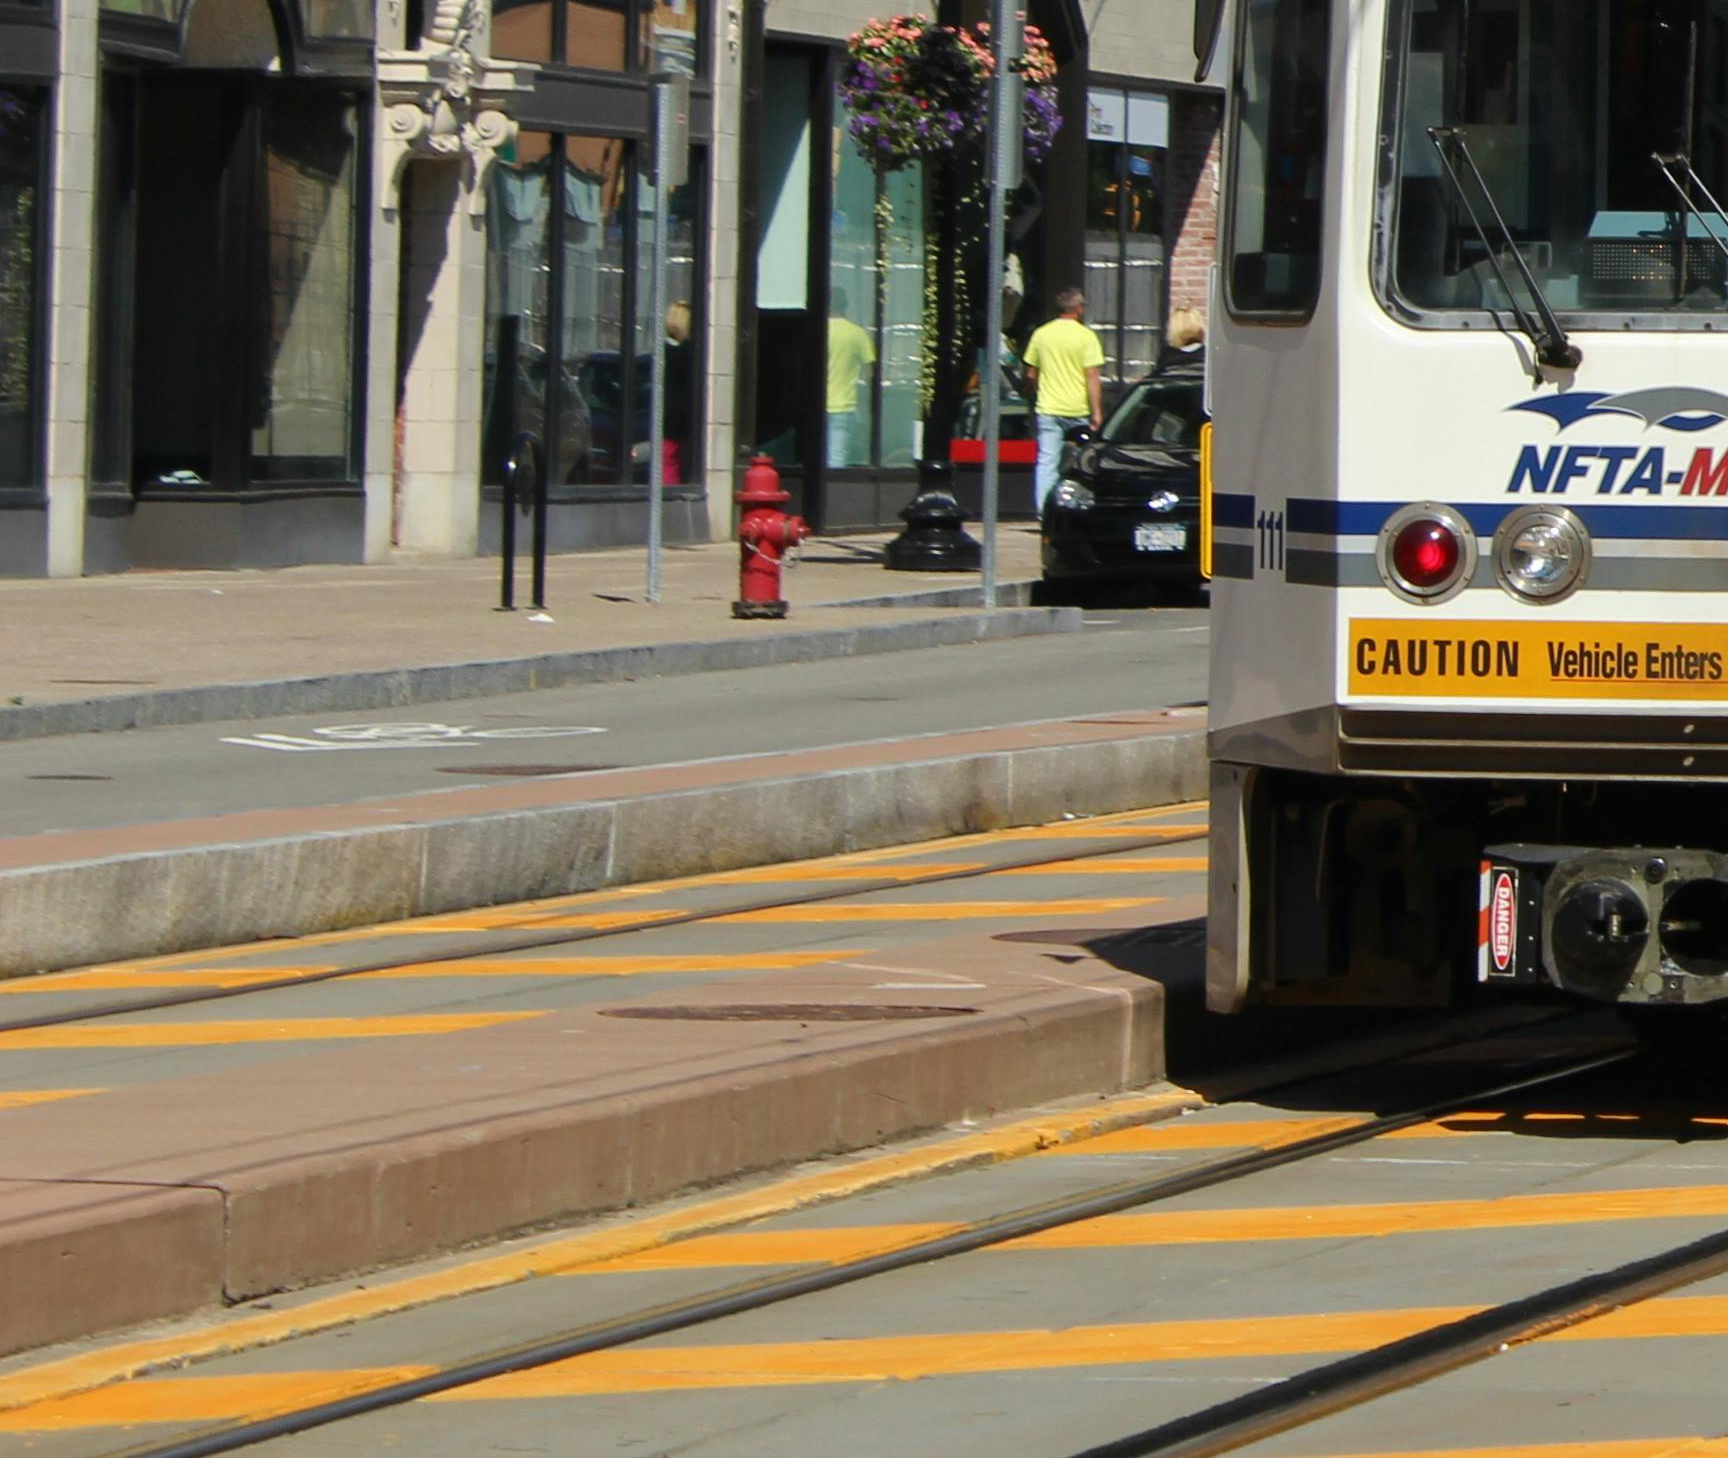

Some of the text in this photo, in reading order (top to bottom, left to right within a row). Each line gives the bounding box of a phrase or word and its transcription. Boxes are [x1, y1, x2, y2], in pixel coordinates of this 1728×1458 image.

[1256, 509, 1285, 571] 111
[1355, 637, 1521, 678] CAUTION
[1547, 639, 1639, 681] Vehicle
[1644, 642, 1722, 682] Enters
[1498, 886, 1510, 957] DANGER
